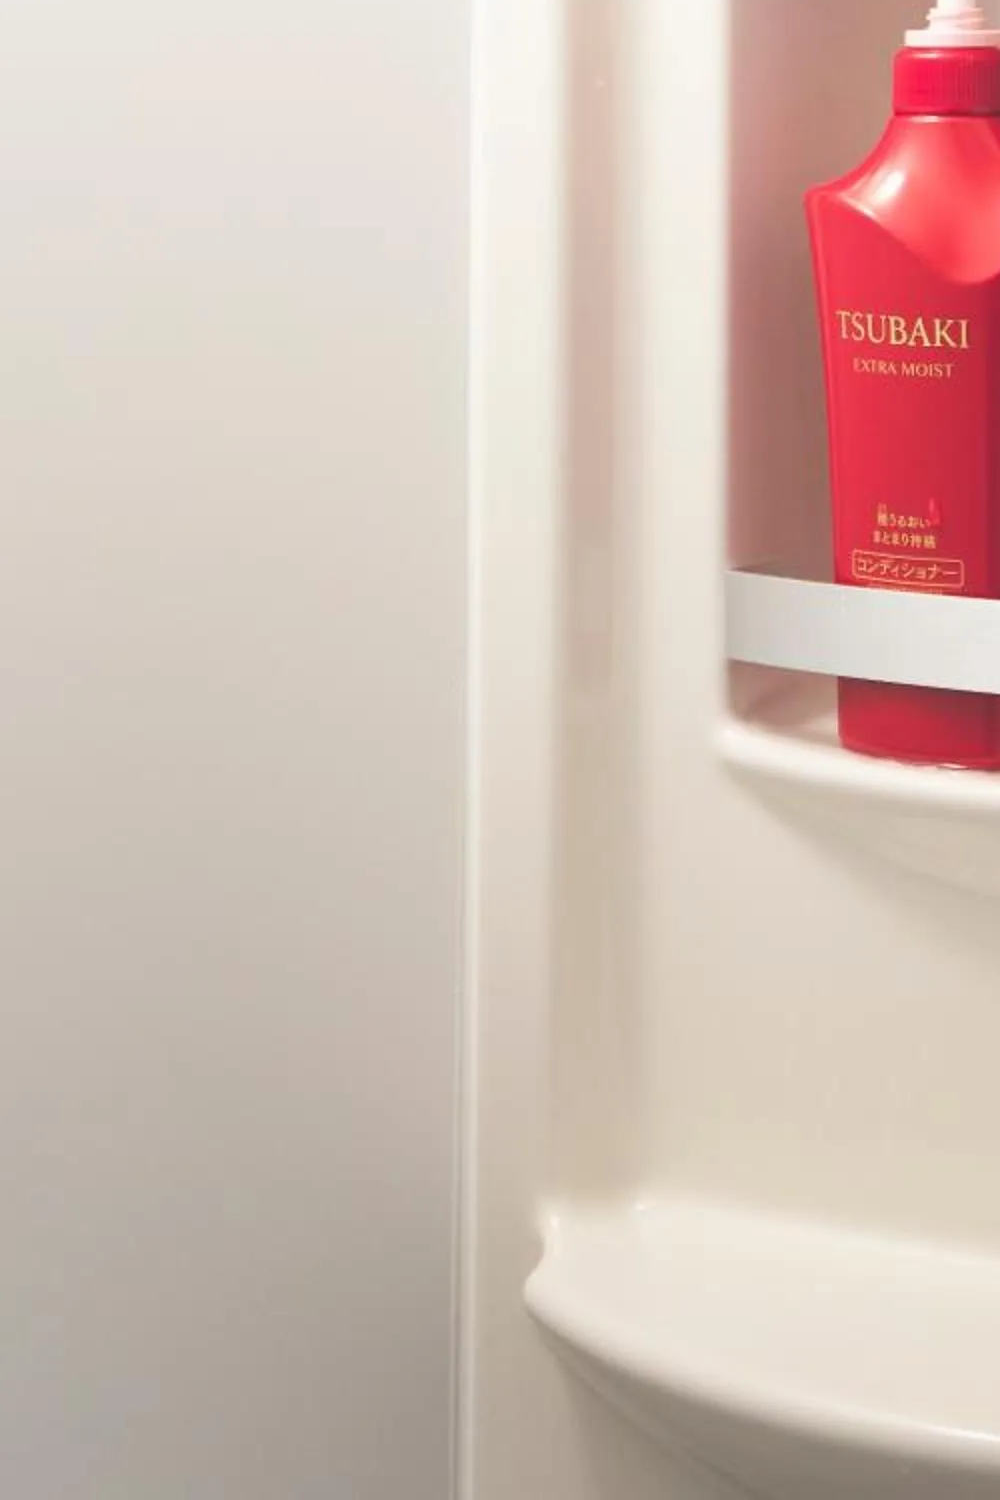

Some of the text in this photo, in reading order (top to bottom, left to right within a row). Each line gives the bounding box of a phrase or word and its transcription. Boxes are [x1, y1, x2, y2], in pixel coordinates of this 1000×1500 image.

[836, 310, 970, 349] TSUBAKI
[852, 357, 955, 378] EXTRA MOIST
[857, 559, 960, 580] コンディショナー
